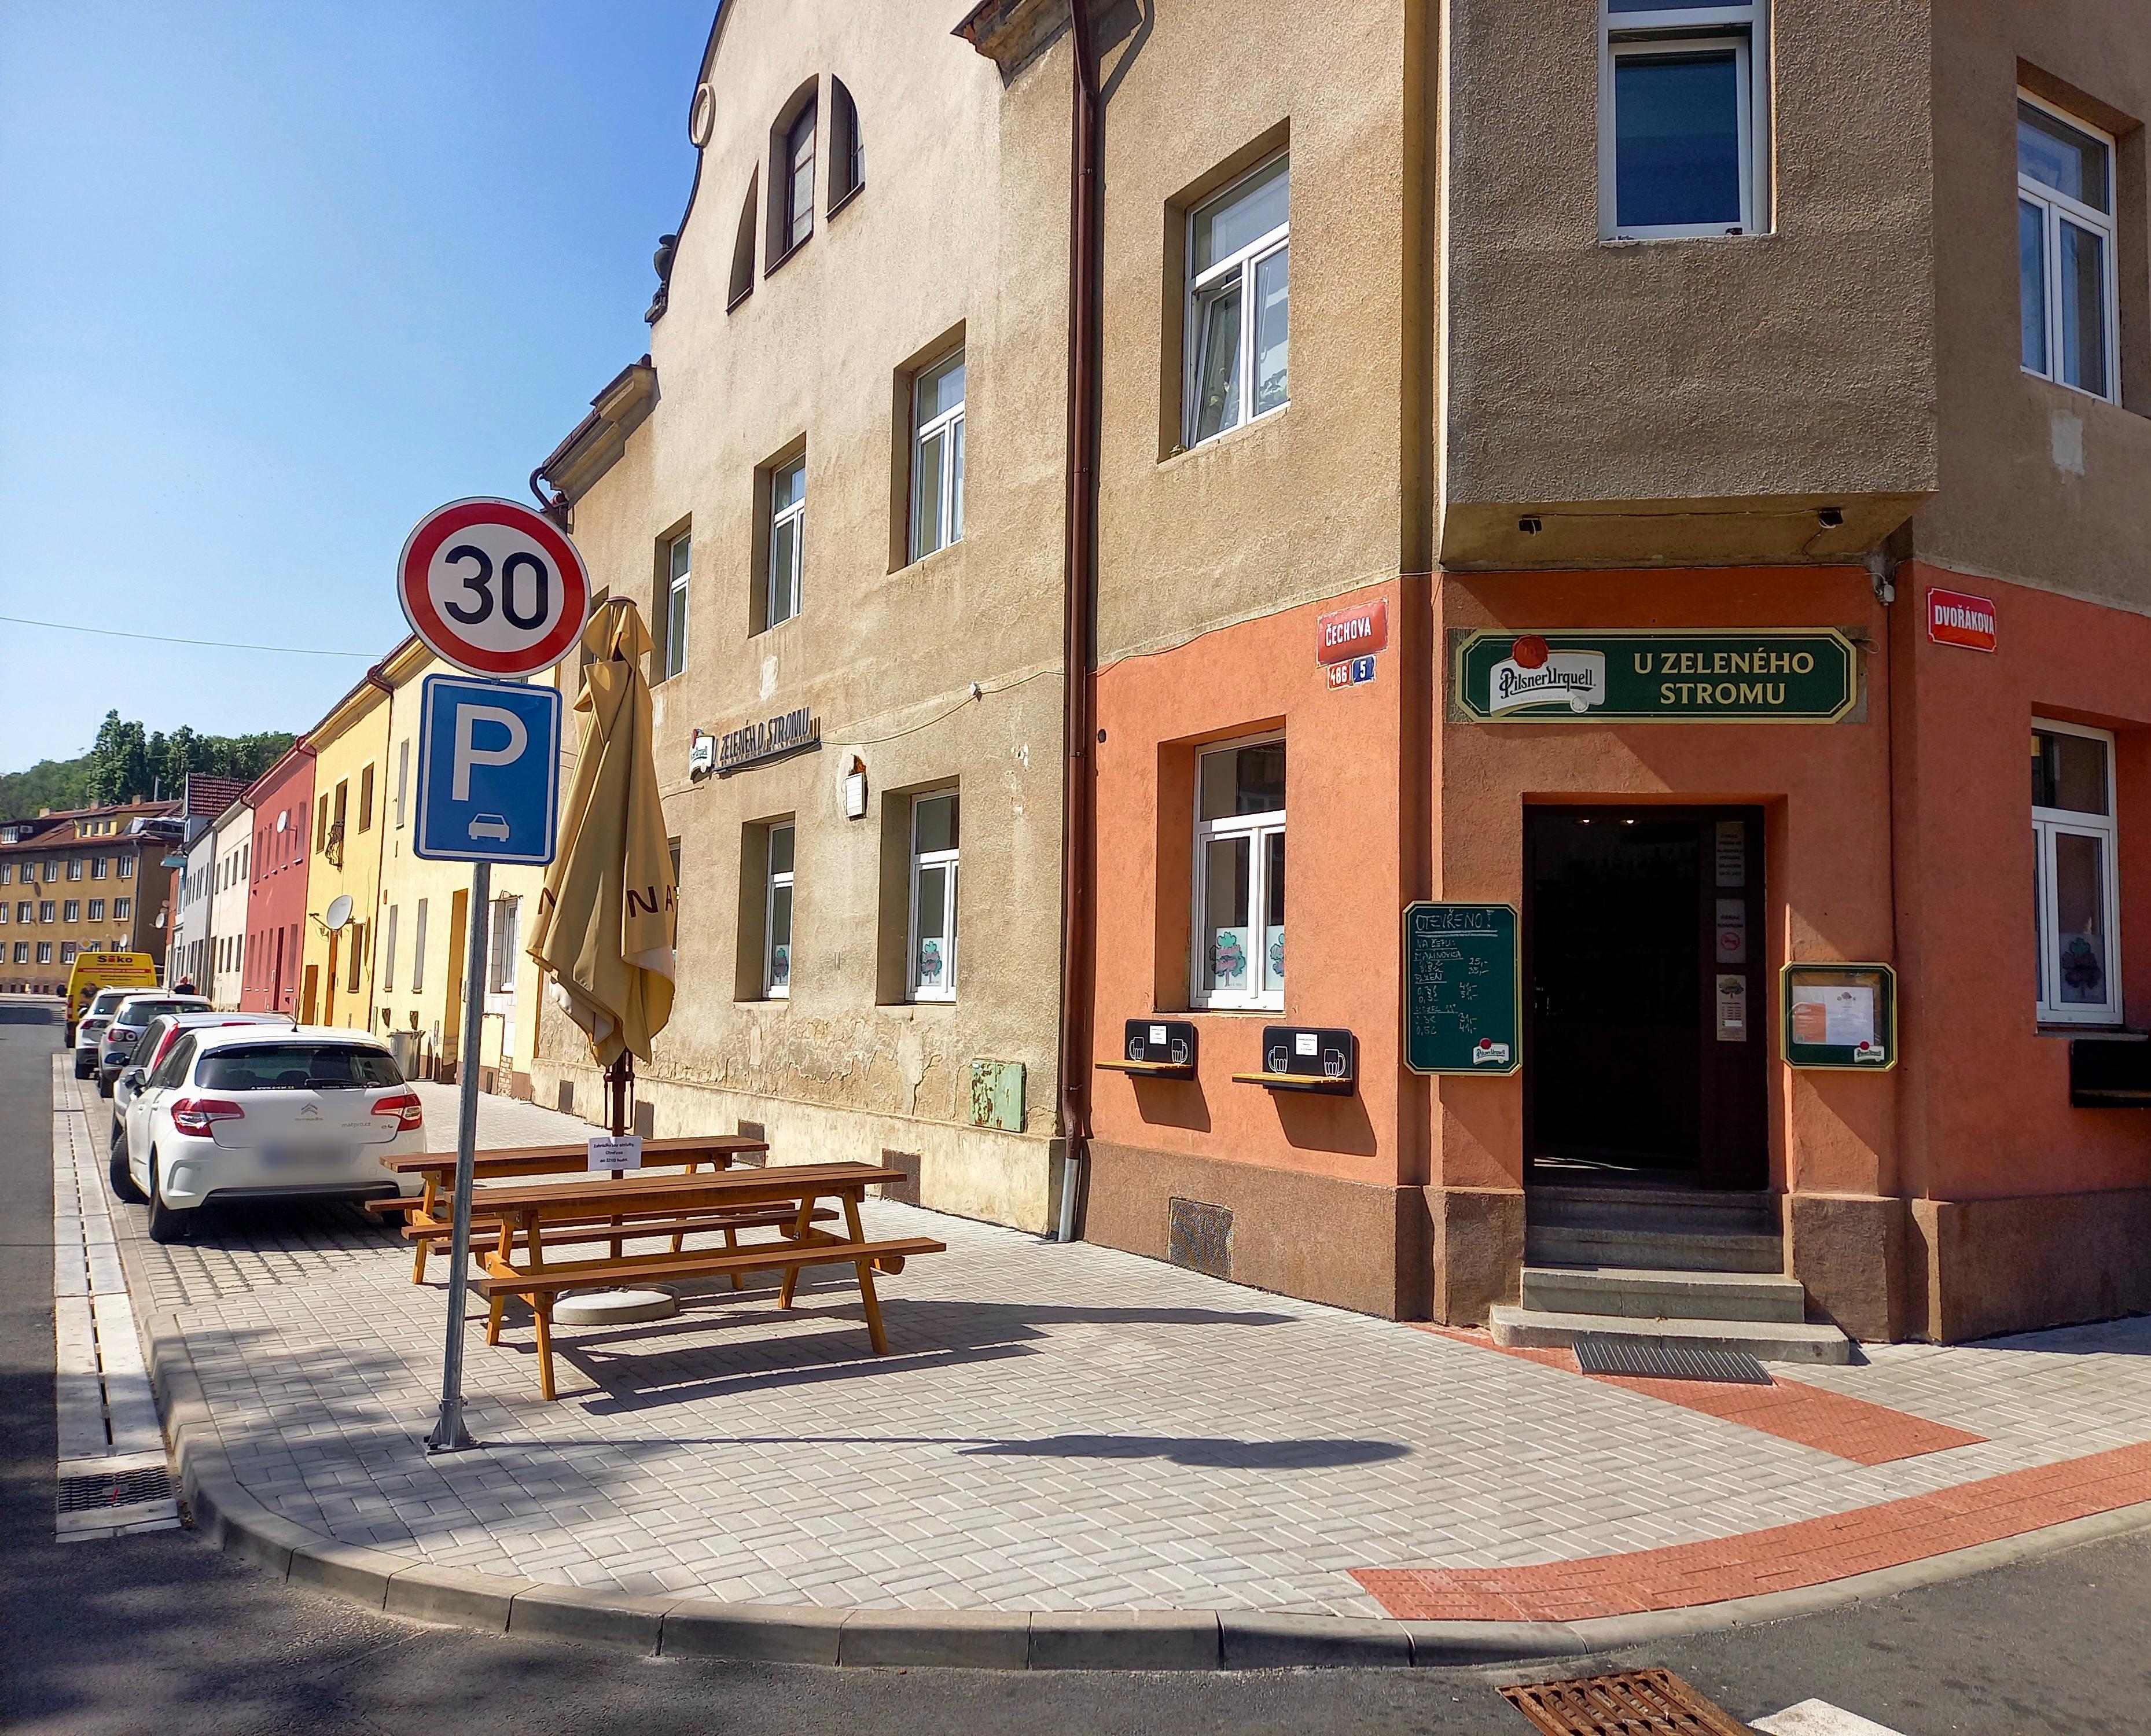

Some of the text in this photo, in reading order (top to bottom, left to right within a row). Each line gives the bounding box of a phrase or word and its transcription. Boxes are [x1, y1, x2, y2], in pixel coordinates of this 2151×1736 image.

[444, 545, 549, 630] 30
[1326, 616, 1372, 646] ČECHOVA
[1935, 604, 1995, 635] DVOŘÁKOVA
[1331, 665, 1347, 685] 486
[1360, 660, 1366, 678] 5
[1634, 648, 1814, 674] U ZELENÉHO
[1499, 666, 1592, 699] Pilsner Urquell
[1660, 683, 1785, 704] STROMU
[768, 707, 810, 745] STROMU
[452, 703, 527, 801] P
